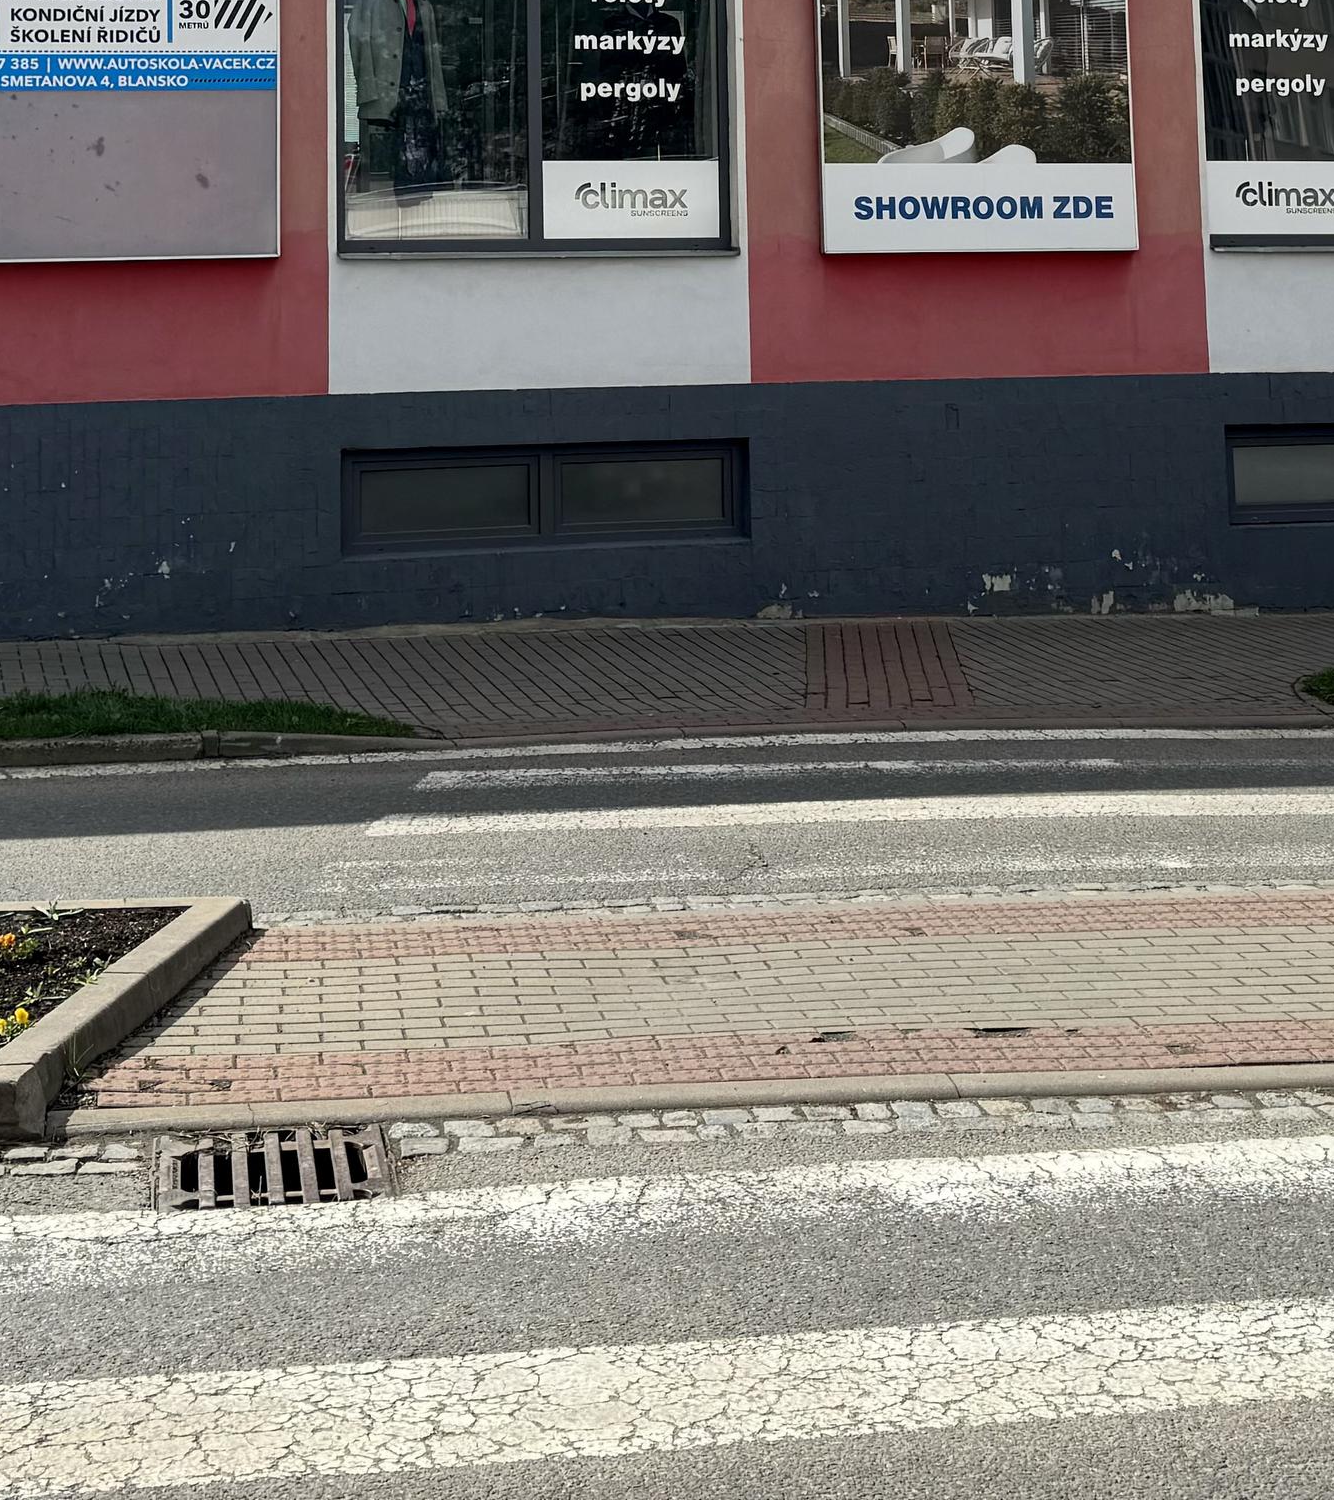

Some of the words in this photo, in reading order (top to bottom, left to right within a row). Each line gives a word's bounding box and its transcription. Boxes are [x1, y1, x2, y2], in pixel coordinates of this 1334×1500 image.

[10, 5, 104, 22] KONDIČNÍ
[109, 6, 161, 22] JÍZDY
[178, 0, 211, 19] 30
[10, 26, 91, 43] ŠKOLENÍ
[97, 26, 161, 43] ŘIDIČŮ
[574, 29, 686, 55] markýzy
[1229, 28, 1328, 52] markýzy
[10, 58, 39, 70] 385
[58, 57, 276, 70] WWW.AUTOSKOLA-VACEK.CZ
[0, 75, 97, 87] SMETANOVA
[100, 75, 114, 88] 4,
[118, 75, 189, 87] BLANSKO
[580, 77, 681, 102] pergoly
[1235, 74, 1326, 97] pergoly
[581, 182, 688, 209] climax
[854, 195, 1043, 220] SHOWROOM
[1053, 195, 1114, 219] ZDE
